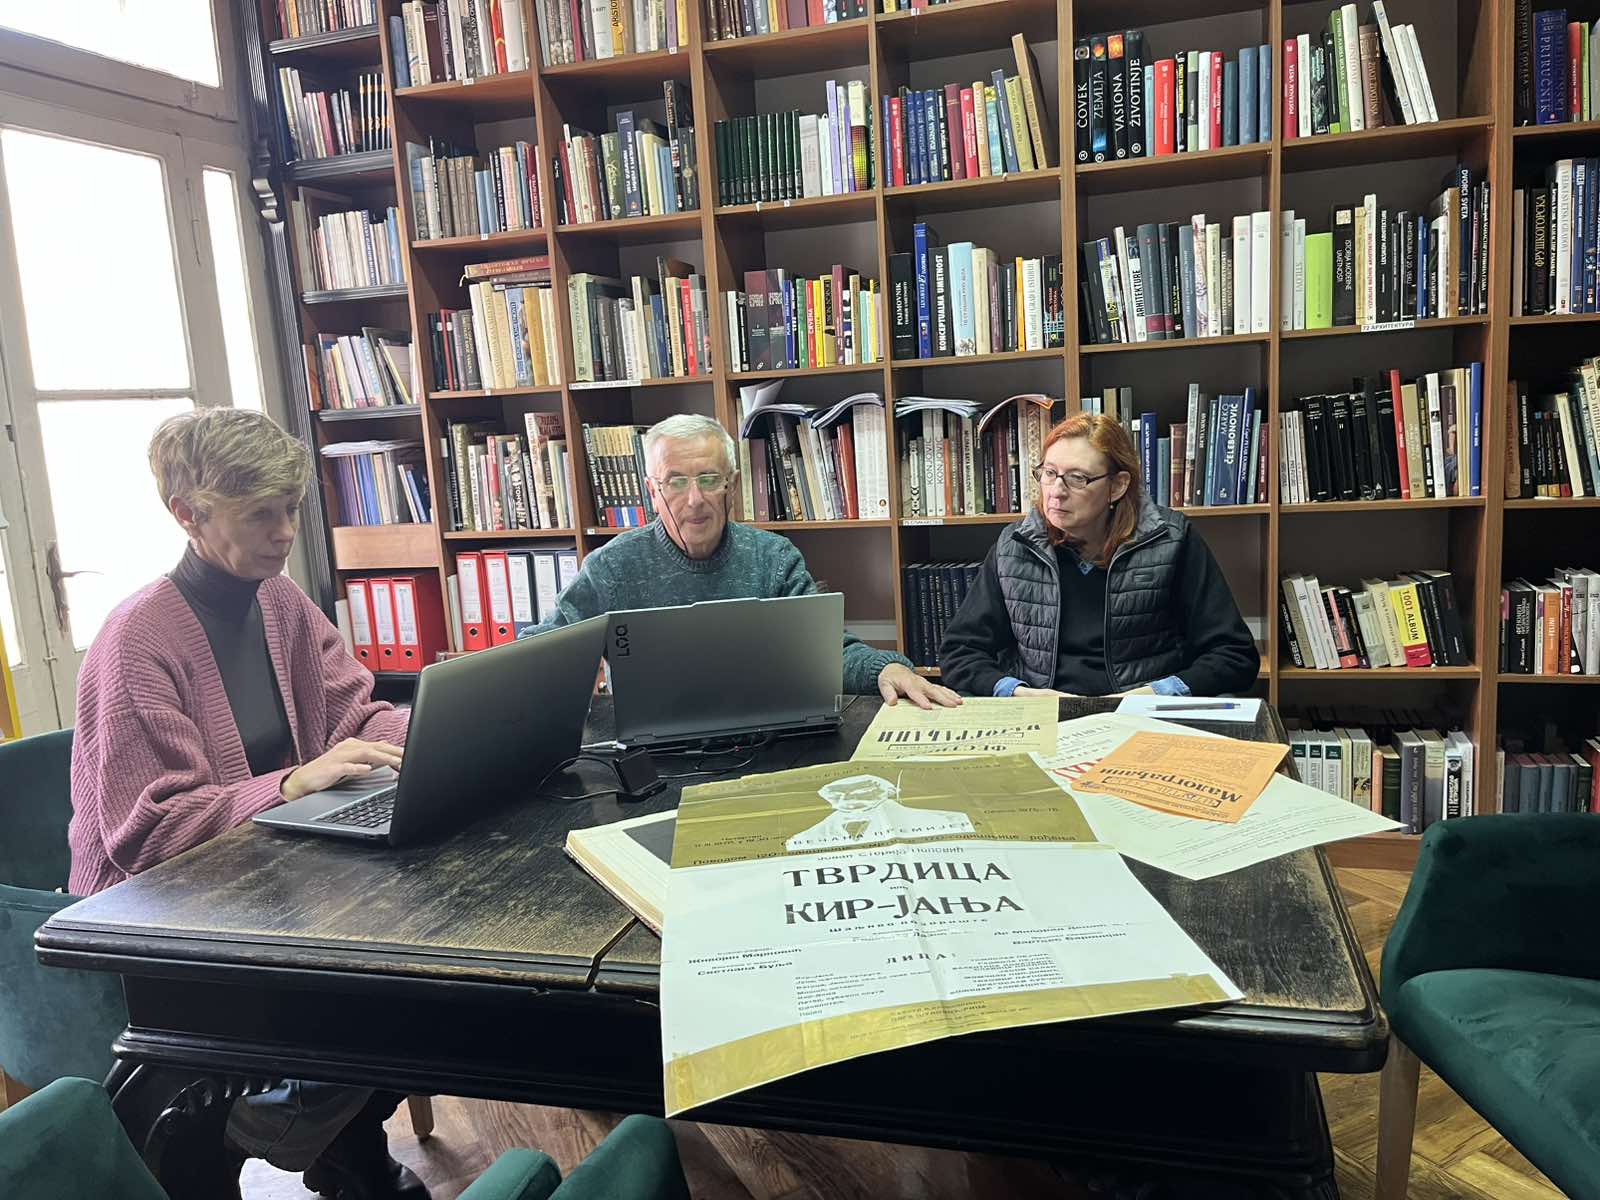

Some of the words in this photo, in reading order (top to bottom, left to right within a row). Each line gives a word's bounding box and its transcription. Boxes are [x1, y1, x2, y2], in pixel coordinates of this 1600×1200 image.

[1540, 36, 1552, 113] PRIRUČNIK
[1076, 83, 1088, 128] ČOVEK
[1093, 71, 1105, 119] ZEMLJA
[1113, 73, 1125, 132] VASIONA
[1129, 58, 1142, 128] ŽIVOTINJE
[1461, 169, 1469, 196] DVORCI
[1535, 194, 1546, 268] ФРУШКОГОРСКА
[935, 255, 945, 293] UMETNOST
[895, 282, 904, 326] POJMOVNIK
[1136, 269, 1145, 318] ARHITEKTURE
[936, 295, 947, 351] KONCEPTUALNA
[1371, 321, 1414, 330] АРХИТЕКТУРА
[1220, 402, 1229, 435] MARKO
[1401, 589, 1412, 611] 1001
[615, 624, 630, 657] LOQ
[1406, 611, 1419, 641] ALBUM
[1099, 768, 1243, 803] Малограђани
[874, 821, 983, 837] ПРЕМИЈЕРА
[782, 861, 1012, 887] ТВРДИЦА
[784, 894, 1025, 925] КИР-ЈАЊА
